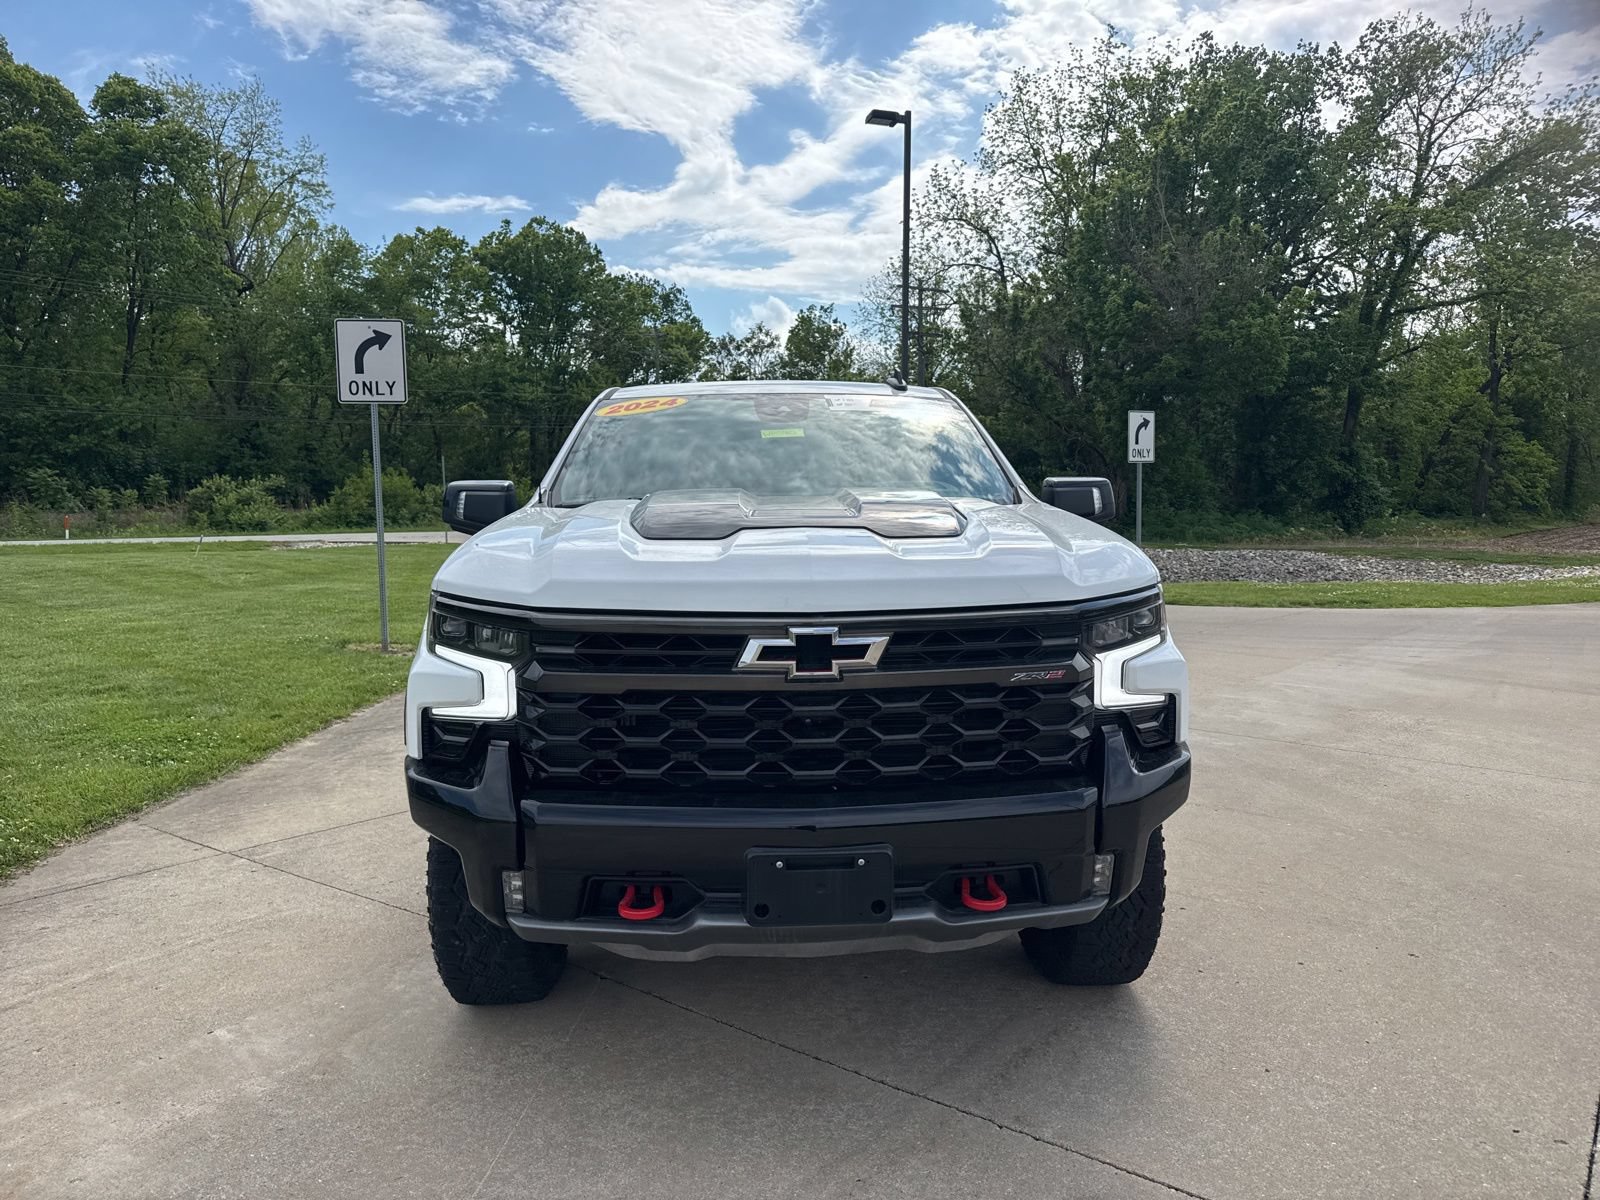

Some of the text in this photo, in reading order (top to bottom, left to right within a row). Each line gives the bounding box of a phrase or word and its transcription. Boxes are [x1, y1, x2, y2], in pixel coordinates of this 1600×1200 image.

[348, 380, 396, 397] ONLY
[603, 398, 680, 416] 2024
[1131, 448, 1151, 459] ONLY
[1010, 669, 1066, 682] ZR2
